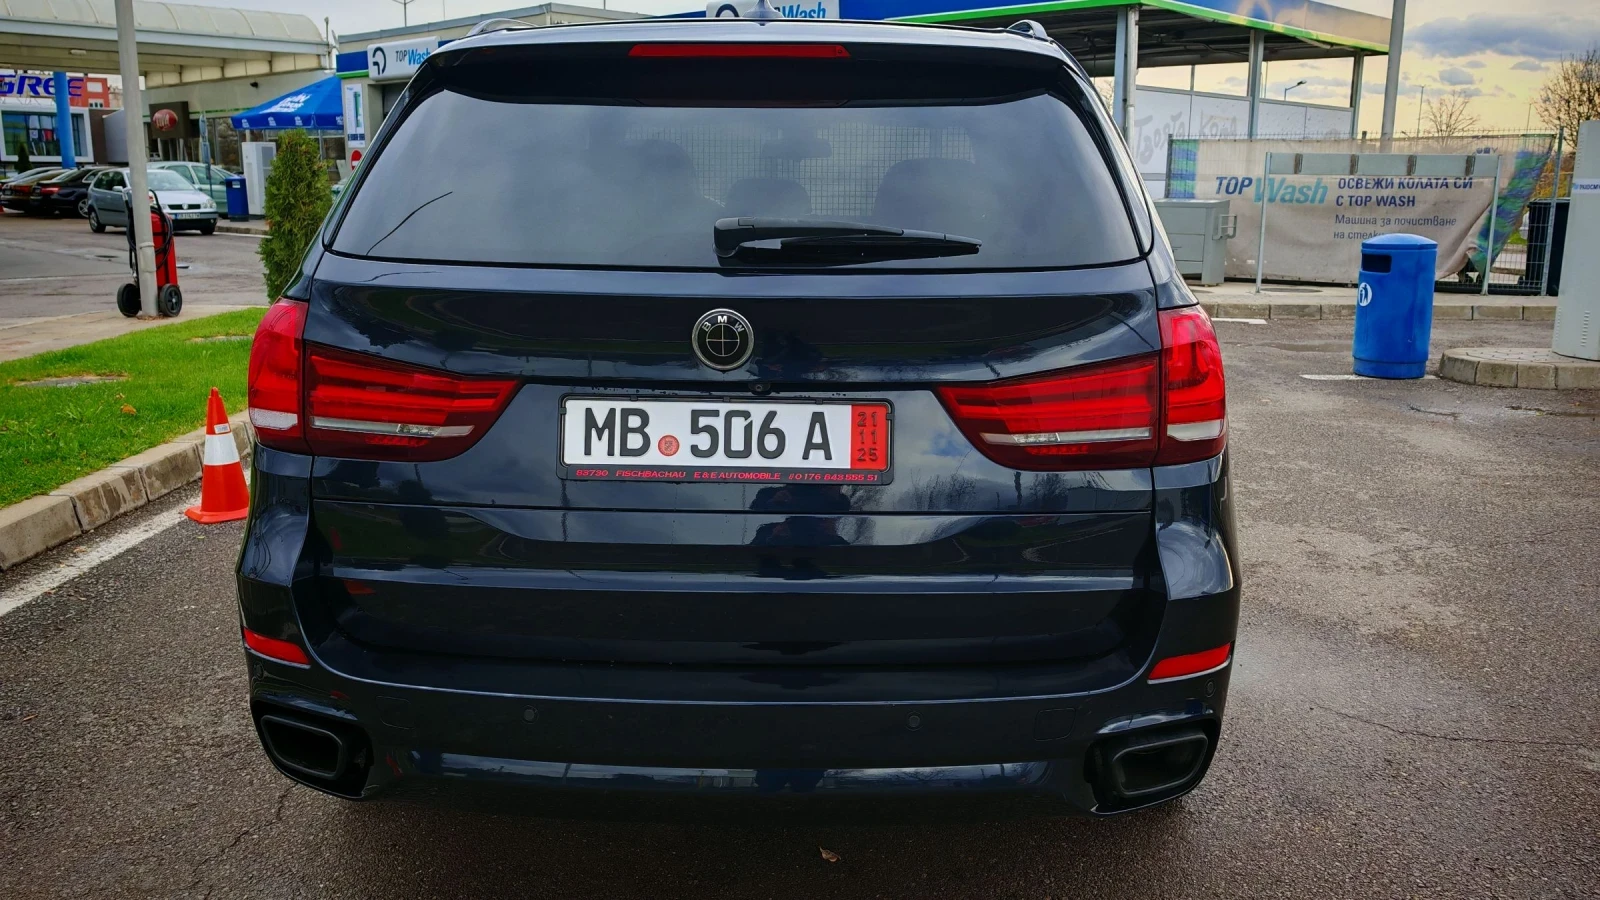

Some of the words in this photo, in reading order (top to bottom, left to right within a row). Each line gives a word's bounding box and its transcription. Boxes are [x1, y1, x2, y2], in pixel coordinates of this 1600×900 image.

[1338, 177, 1395, 190] ОСВЕЖИ
[1397, 177, 1449, 190] КОЛАТА
[1453, 177, 1473, 190] СИ
[1347, 195, 1372, 207] TOP
[1375, 195, 1416, 207] WASH
[1335, 214, 1377, 226] Машина
[1379, 217, 1391, 227] за
[1394, 216, 1457, 227] почистване
[1333, 231, 1345, 239] на
[701, 315, 745, 333] BMW
[857, 411, 878, 428] 21
[584, 407, 652, 457] MB
[690, 409, 786, 460] 506
[801, 411, 833, 461] A
[859, 428, 878, 445] 11
[856, 447, 879, 462] 25
[615, 470, 686, 478] FISCHBACHAU
[718, 472, 781, 480] AUTOMOBILE
